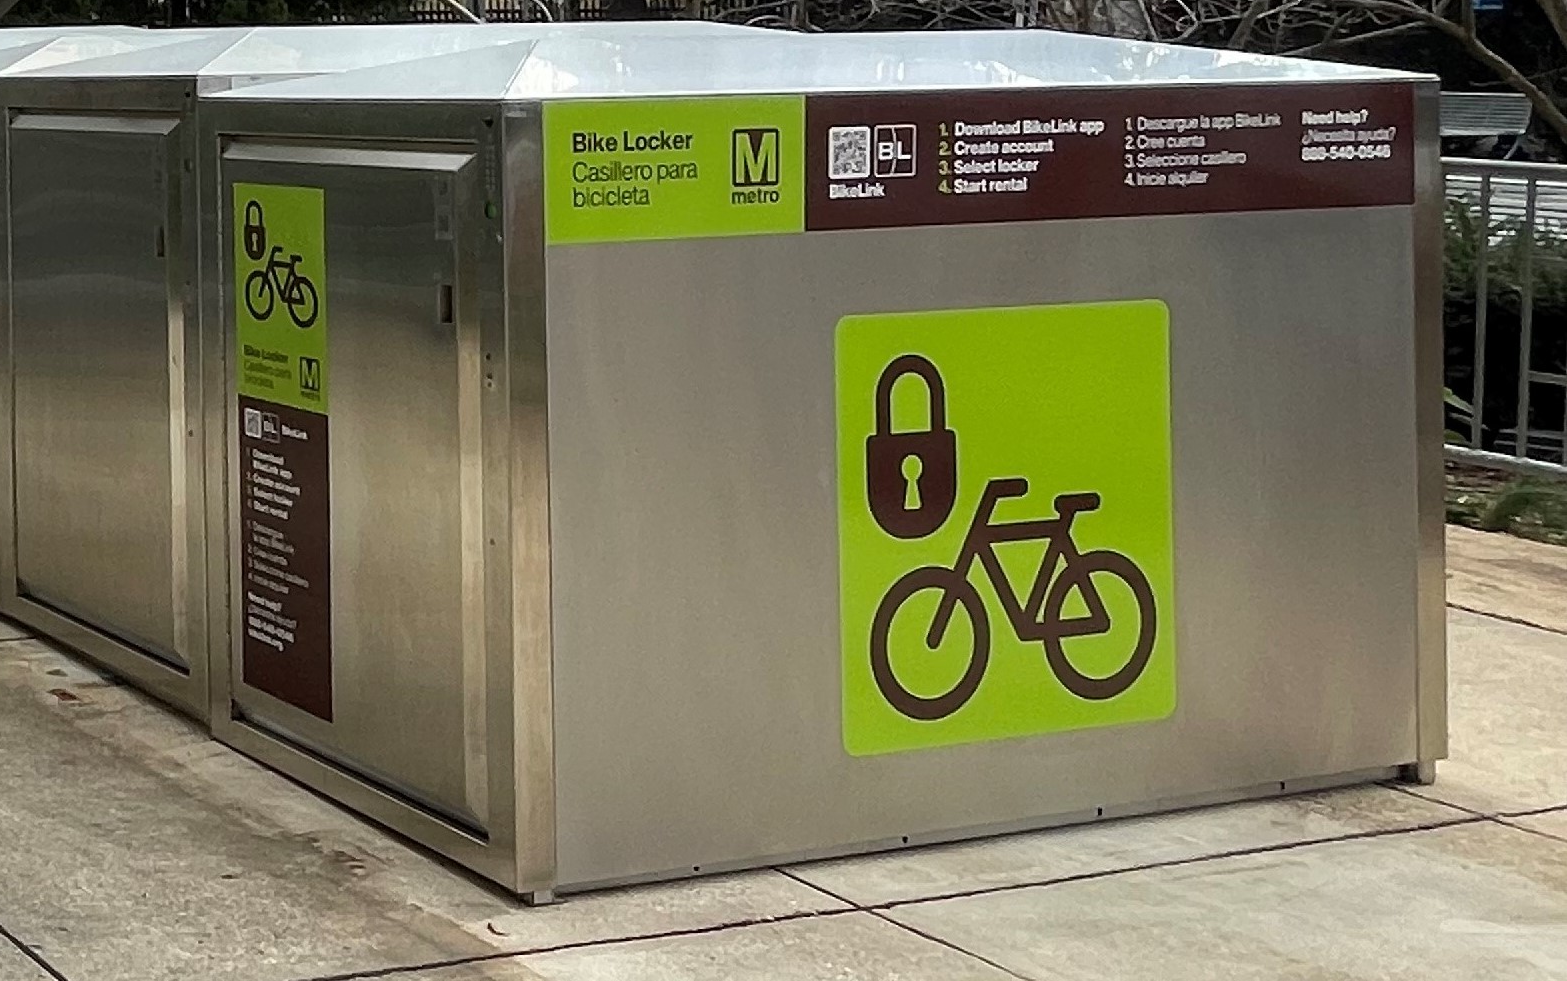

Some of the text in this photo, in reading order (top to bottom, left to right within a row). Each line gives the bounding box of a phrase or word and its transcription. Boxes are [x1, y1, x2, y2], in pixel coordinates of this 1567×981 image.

[954, 120, 1021, 136] Download
[1022, 119, 1077, 134] BikeLink
[1079, 120, 1105, 135] app
[572, 130, 693, 152] Bike Locker
[954, 140, 999, 156] Create
[1001, 139, 1054, 154] account
[735, 132, 777, 184] M
[953, 159, 996, 174] Select
[997, 158, 1039, 172] locker
[572, 161, 698, 184] Casillero para
[829, 182, 886, 199] BikeLink
[953, 178, 987, 194] Start
[989, 177, 1028, 192] rental
[572, 186, 650, 208] bicicleta
[731, 189, 779, 205] metro
[301, 358, 318, 390] M
